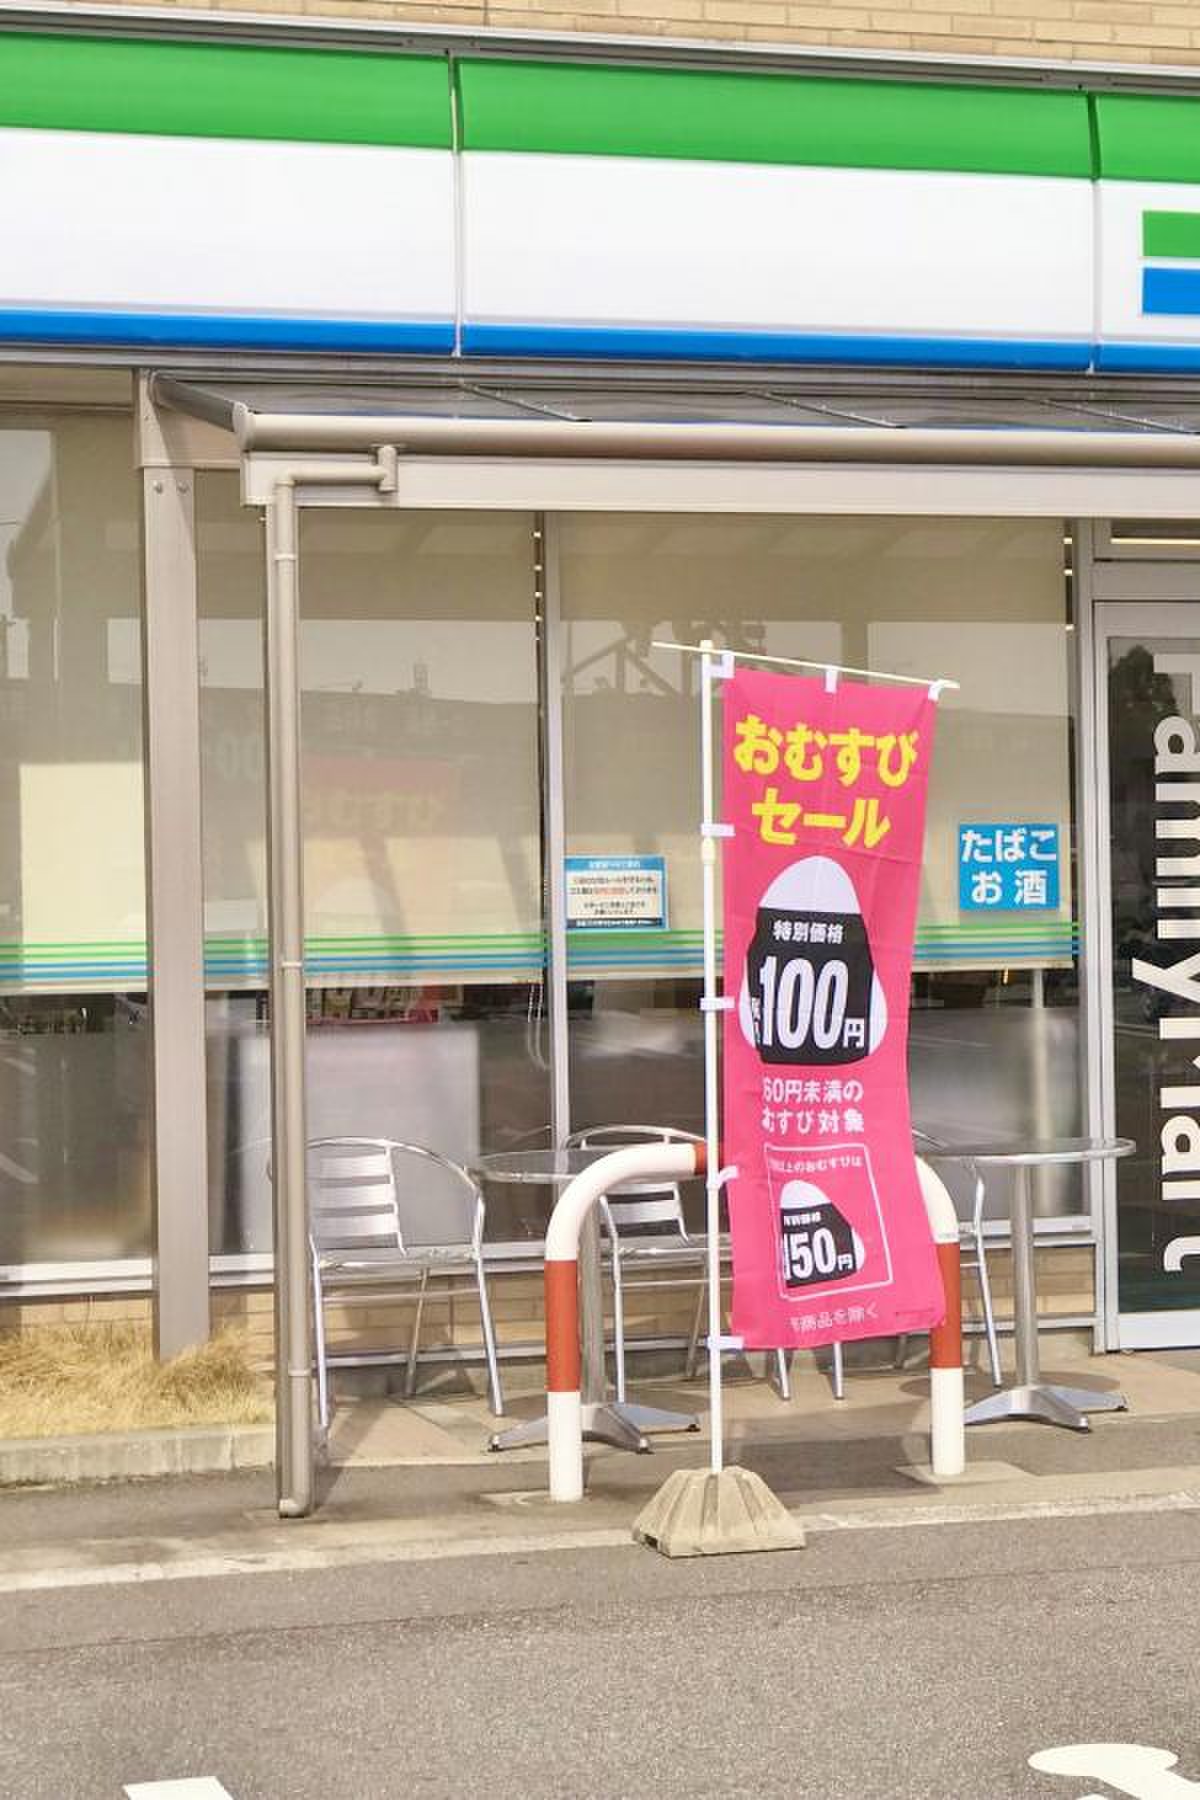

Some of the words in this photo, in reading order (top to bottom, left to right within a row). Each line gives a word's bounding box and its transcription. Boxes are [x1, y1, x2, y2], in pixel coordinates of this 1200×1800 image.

[733, 714, 920, 788] おむすび
[751, 787, 892, 849] セール
[961, 827, 1057, 863] たばこ
[971, 869, 1048, 905] お酒
[773, 919, 844, 944] 特別価格
[759, 955, 865, 1049] 100円
